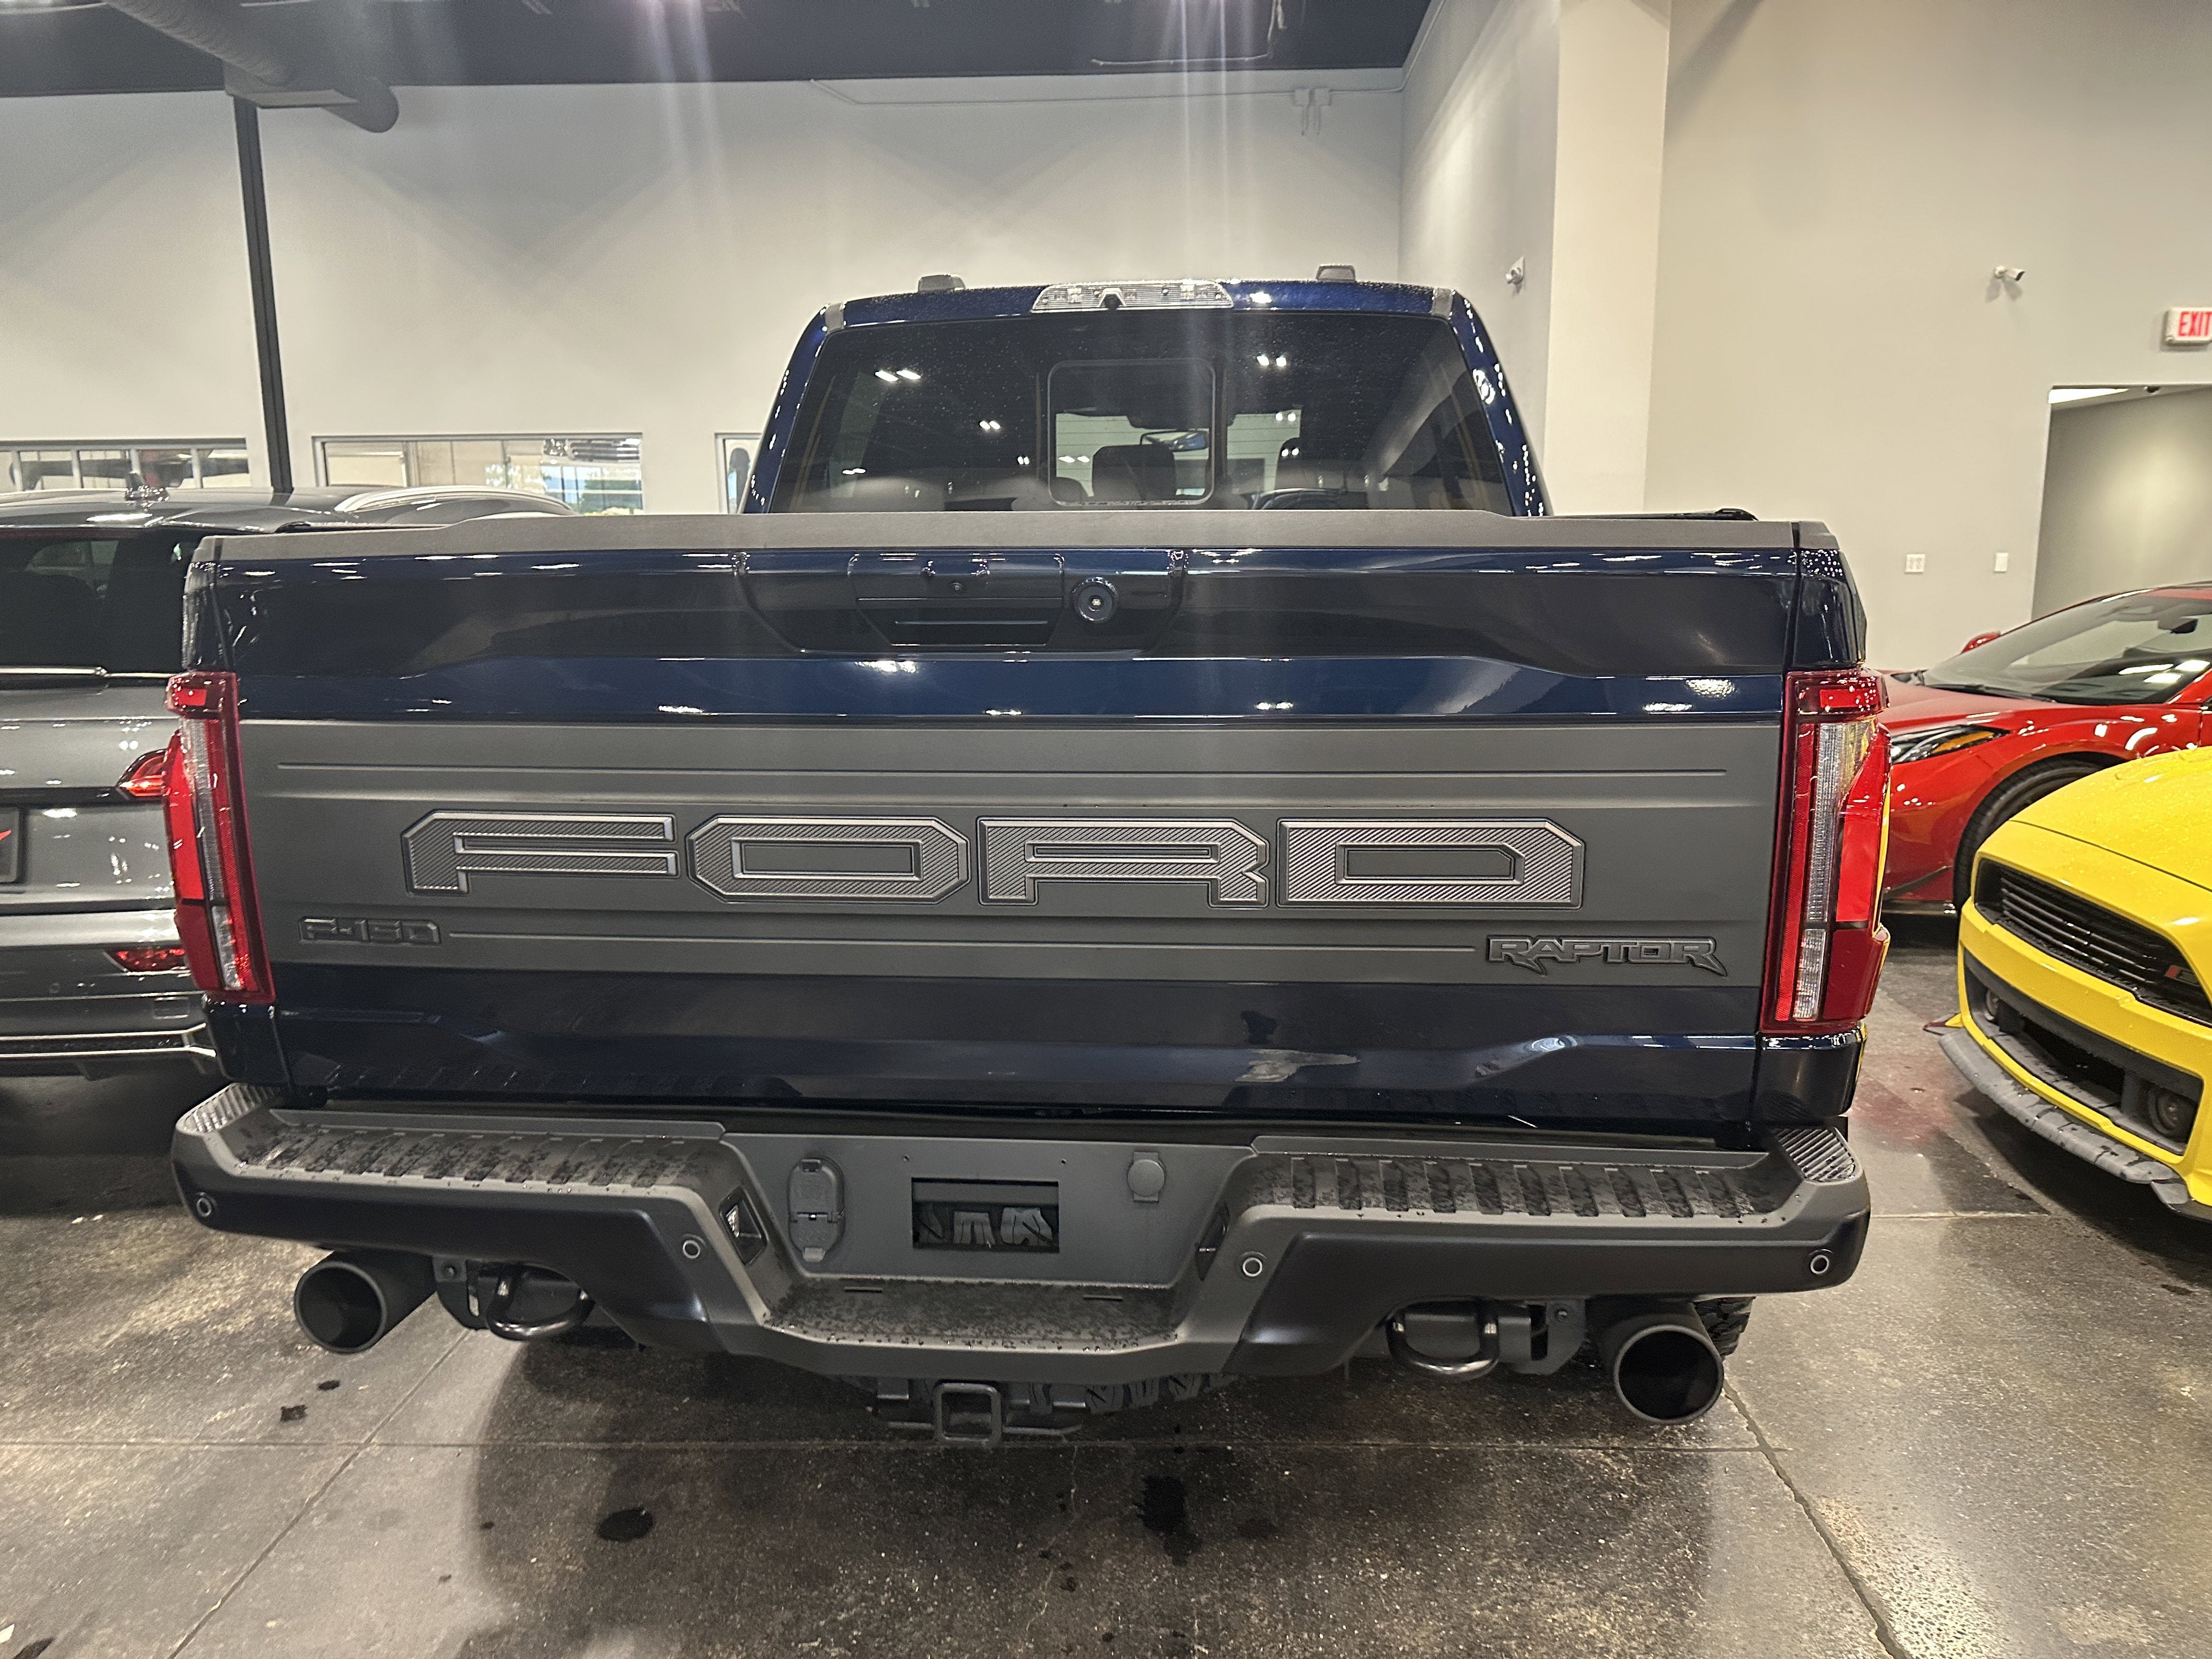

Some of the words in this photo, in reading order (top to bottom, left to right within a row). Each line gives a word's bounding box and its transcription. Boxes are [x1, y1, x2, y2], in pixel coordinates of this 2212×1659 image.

[2178, 311, 2212, 336] EXIT
[402, 810, 1584, 909] FORD
[301, 917, 441, 945] F-150
[1486, 935, 1728, 976] RAPTOR
